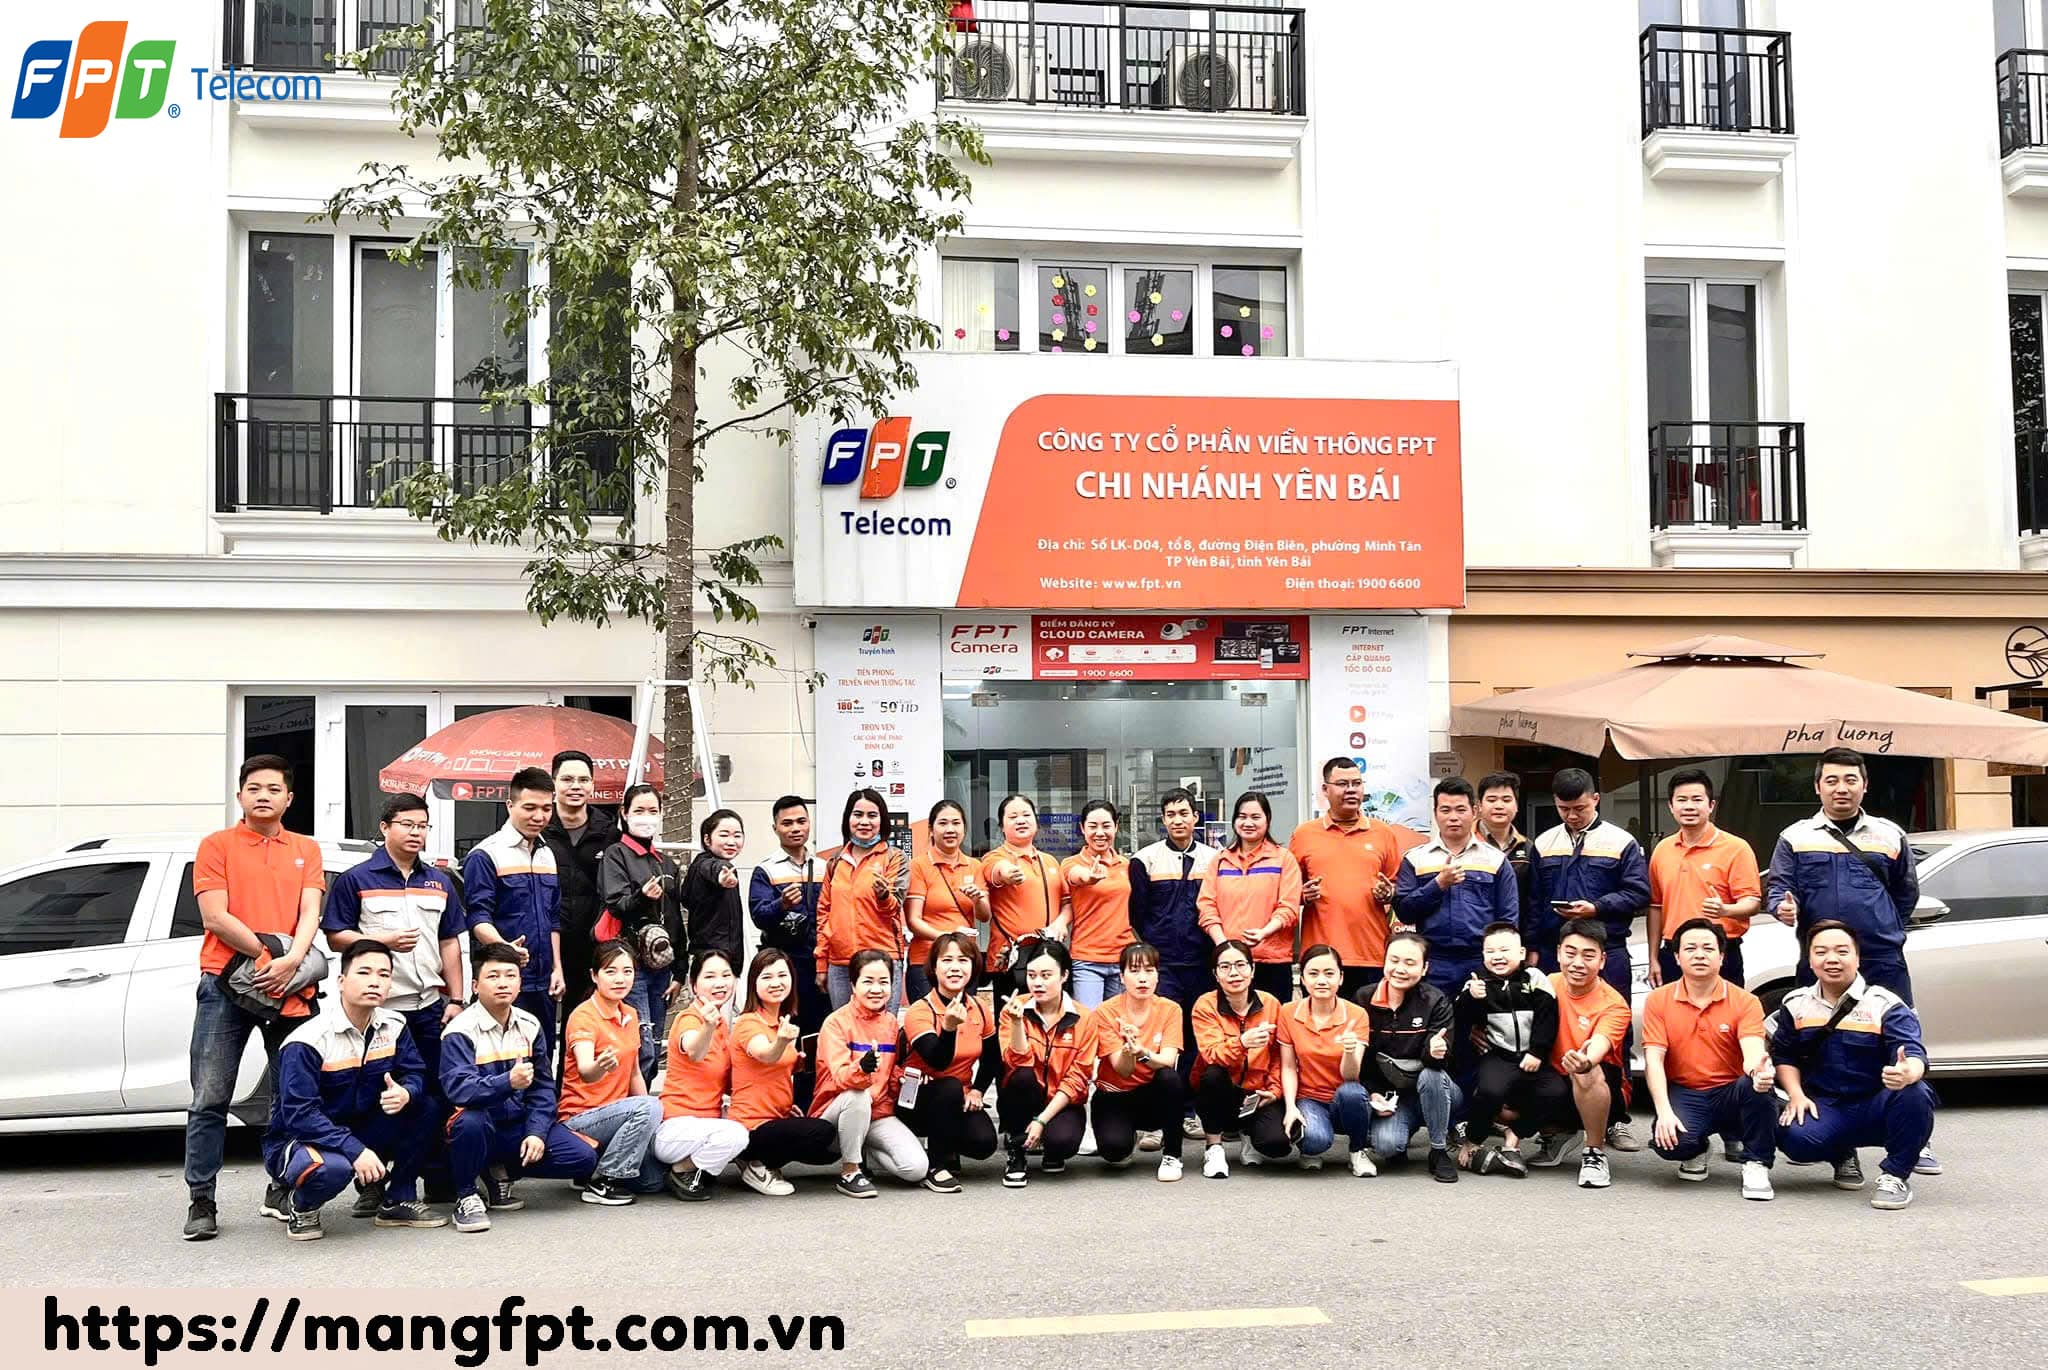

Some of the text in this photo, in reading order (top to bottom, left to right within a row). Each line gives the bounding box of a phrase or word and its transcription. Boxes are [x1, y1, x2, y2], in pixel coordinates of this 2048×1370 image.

[1038, 424, 1437, 456] CÔNG TY CỔ PHẦN VIỄN THÔNG FPT
[1075, 465, 1400, 501] CHI NHÁNH YÊN BÁI
[840, 509, 951, 536] Telecom
[1037, 538, 1060, 552] Địa
[1091, 537, 1107, 551] Số
[1111, 539, 1163, 552] LK-D04,
[1244, 539, 1274, 552] Điện
[1277, 540, 1308, 553] Biên,
[1312, 539, 1361, 554] phường
[1365, 540, 1396, 551] Minh
[1400, 540, 1422, 551] Tân
[1166, 555, 1182, 567] TP
[1185, 555, 1207, 567] Yên
[1266, 555, 1288, 567] Yên
[1291, 555, 1312, 567] Bái
[1040, 577, 1182, 591] Website: www.fpt.vn
[1285, 578, 1421, 591] Điện thoại: 1900 6600
[951, 625, 1018, 638] FPT
[1040, 630, 1145, 639] CLOUD CAMERA
[1342, 626, 1368, 635] FPT
[951, 641, 1018, 654] Camera
[1082, 669, 1106, 677] 1900
[1109, 669, 1134, 677] 6600
[1782, 723, 1824, 751] pha
[476, 785, 506, 799] FPT
